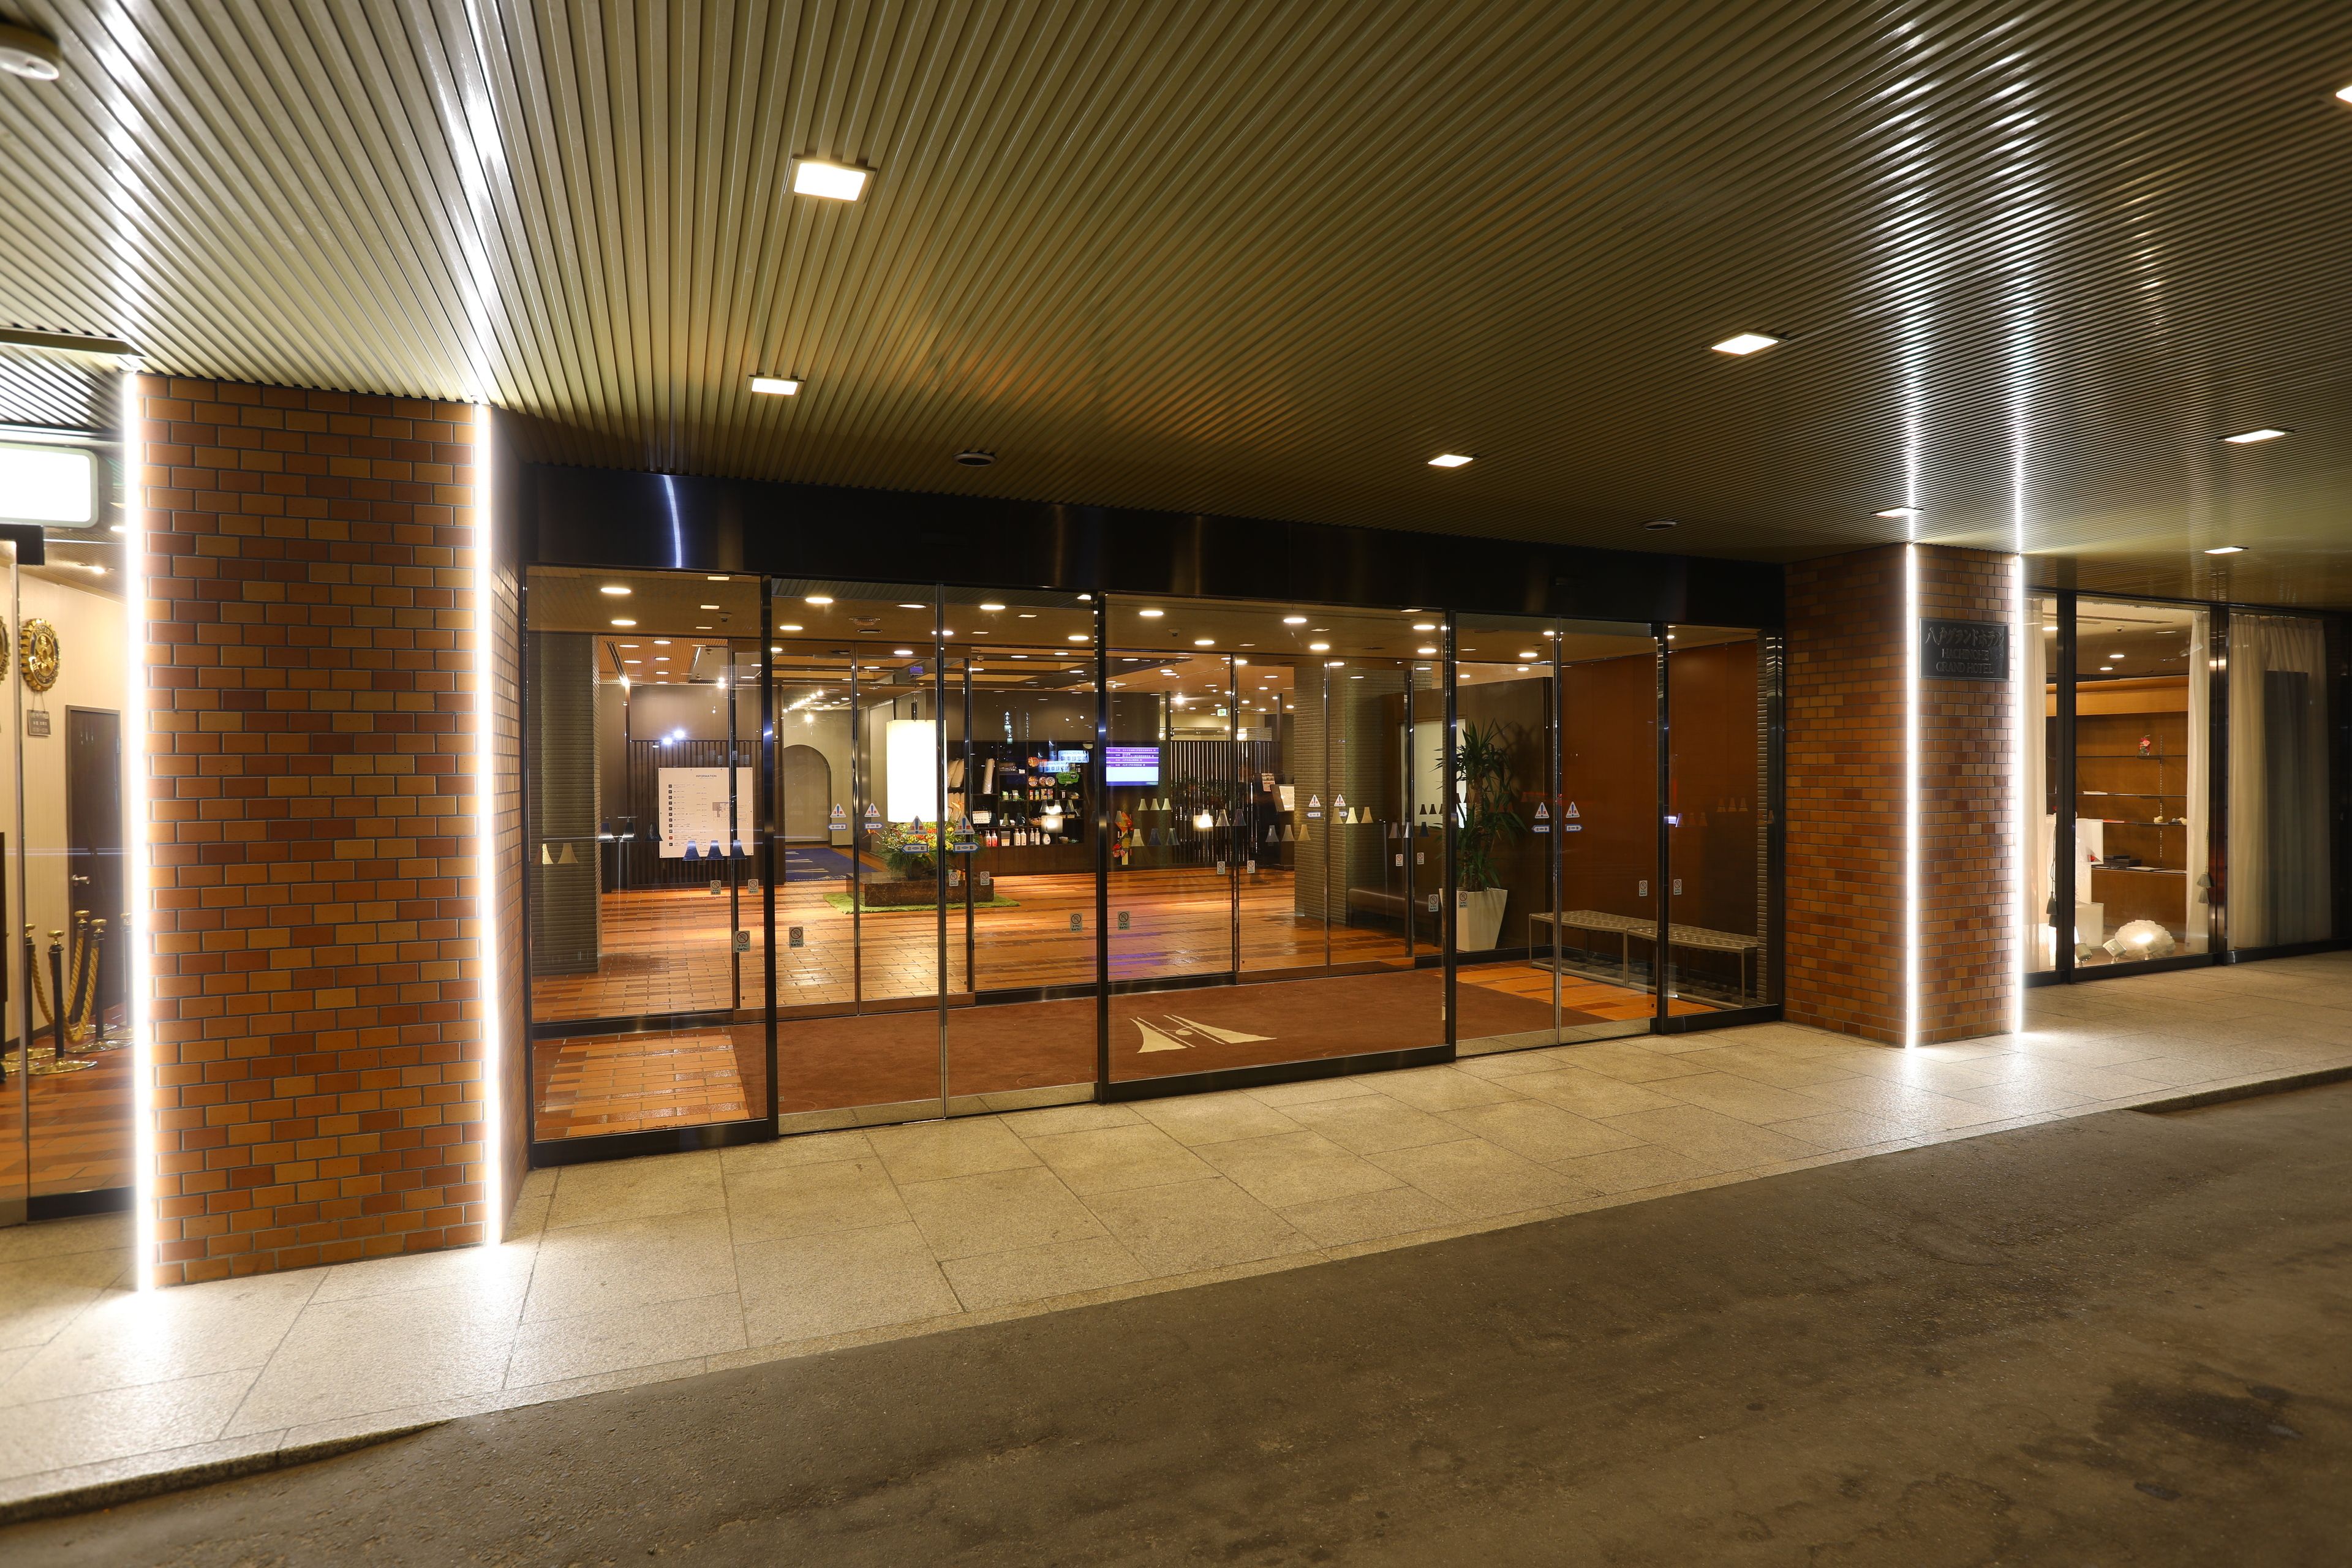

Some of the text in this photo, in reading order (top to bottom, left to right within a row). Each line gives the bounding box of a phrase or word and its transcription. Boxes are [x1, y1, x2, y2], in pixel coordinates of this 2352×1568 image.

[1924, 627, 2004, 647] 八戸グランドホテル
[1942, 648, 1989, 661] HACHINOHE
[1936, 662, 1995, 674] GRAND HOTEL
